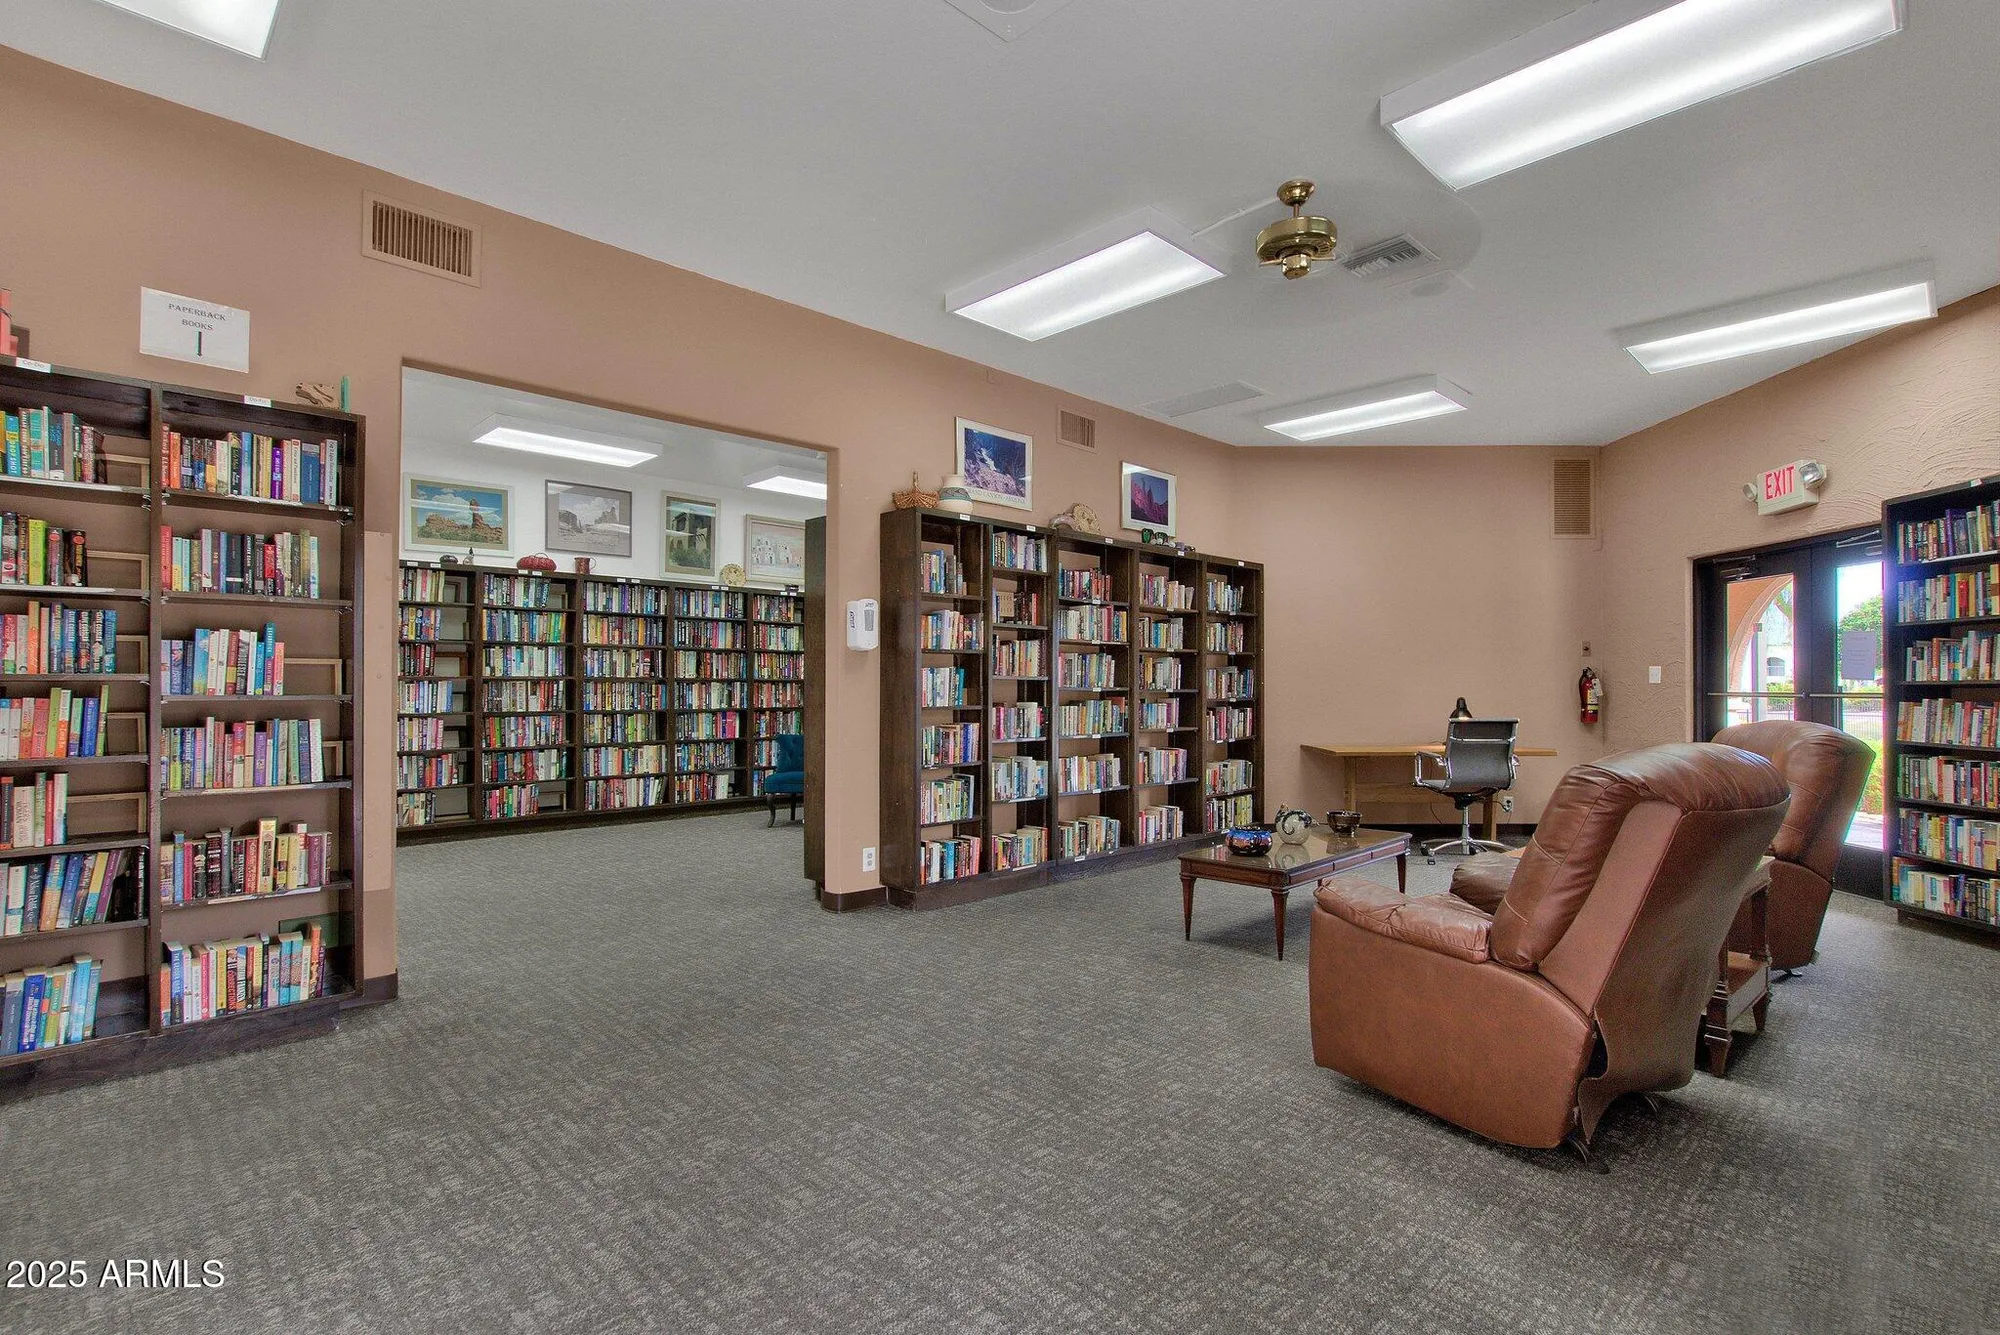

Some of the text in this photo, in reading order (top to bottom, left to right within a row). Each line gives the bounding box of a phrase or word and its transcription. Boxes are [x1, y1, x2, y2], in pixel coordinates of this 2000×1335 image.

[168, 303, 226, 321] PAPERBACK
[181, 318, 213, 331] BOOKS
[1764, 465, 1796, 500] EXIT
[68, 610, 76, 642] CLIVE CUSSLER
[81, 611, 89, 642] CLIVE CUSSLER
[95, 611, 103, 642] CLIVE CUSSLER
[227, 969, 237, 1010] CORRECTIONS
